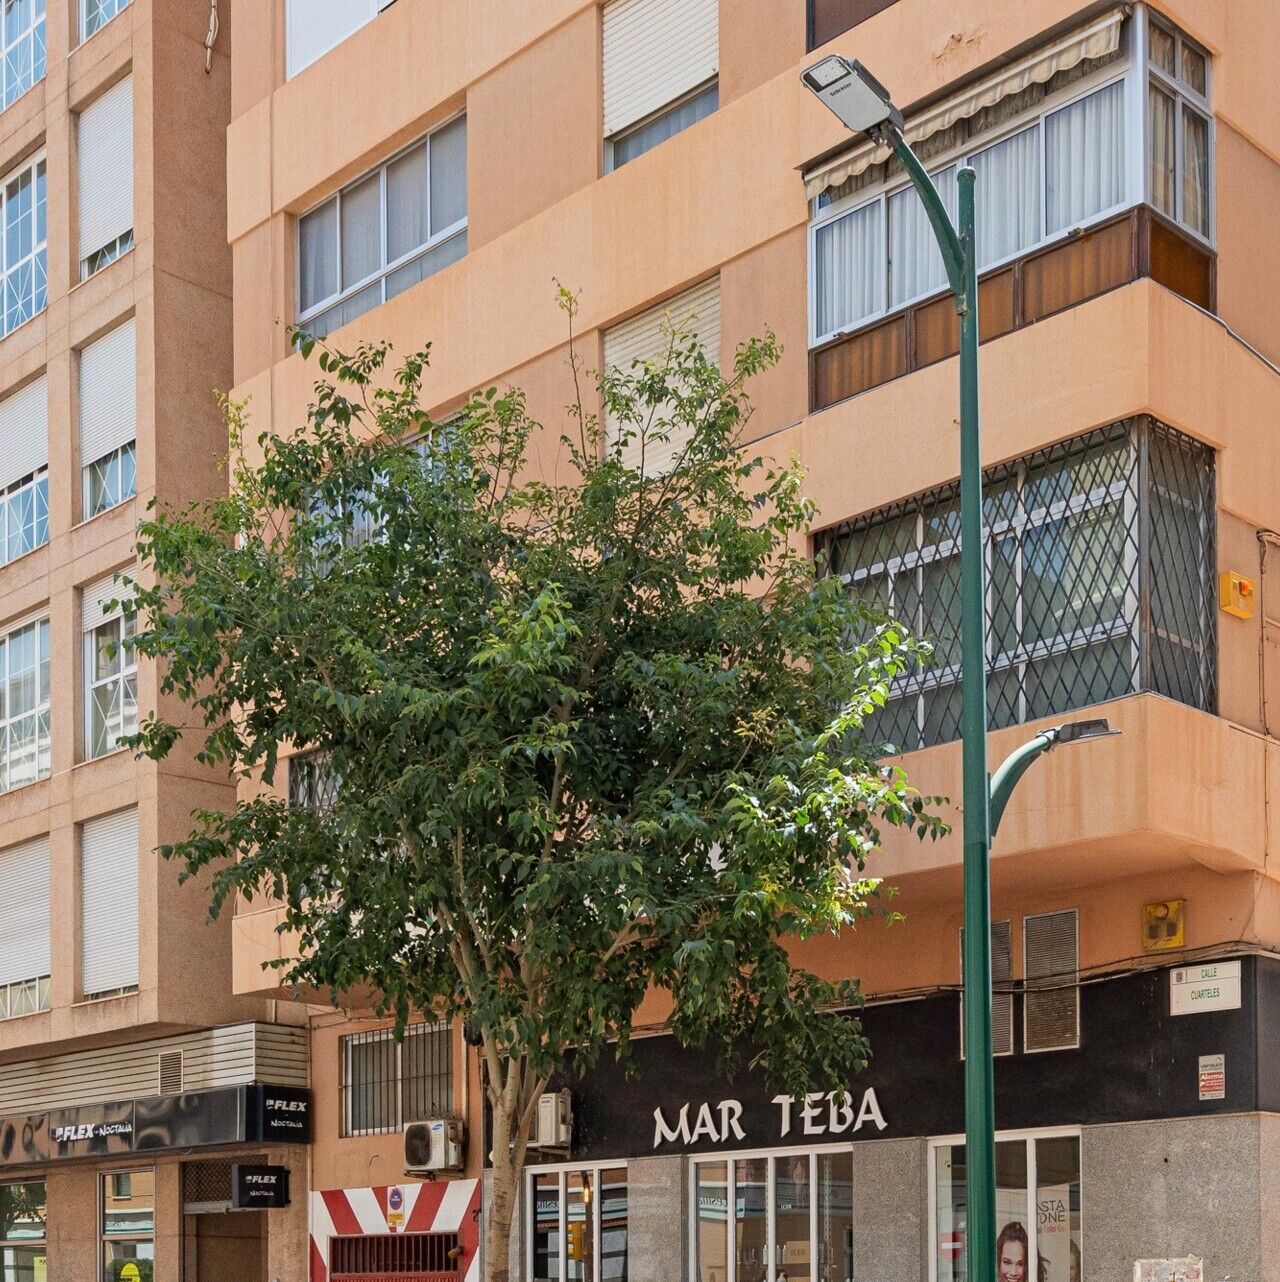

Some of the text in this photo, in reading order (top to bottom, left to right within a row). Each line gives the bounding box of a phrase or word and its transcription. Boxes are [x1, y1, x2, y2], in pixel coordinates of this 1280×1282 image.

[1201, 968, 1217, 979] CALLE
[1190, 988, 1220, 1000] CUARTELES
[274, 1100, 307, 1111] FLEX
[653, 1087, 888, 1148] MAR TEBA
[63, 1124, 94, 1141] FLEX
